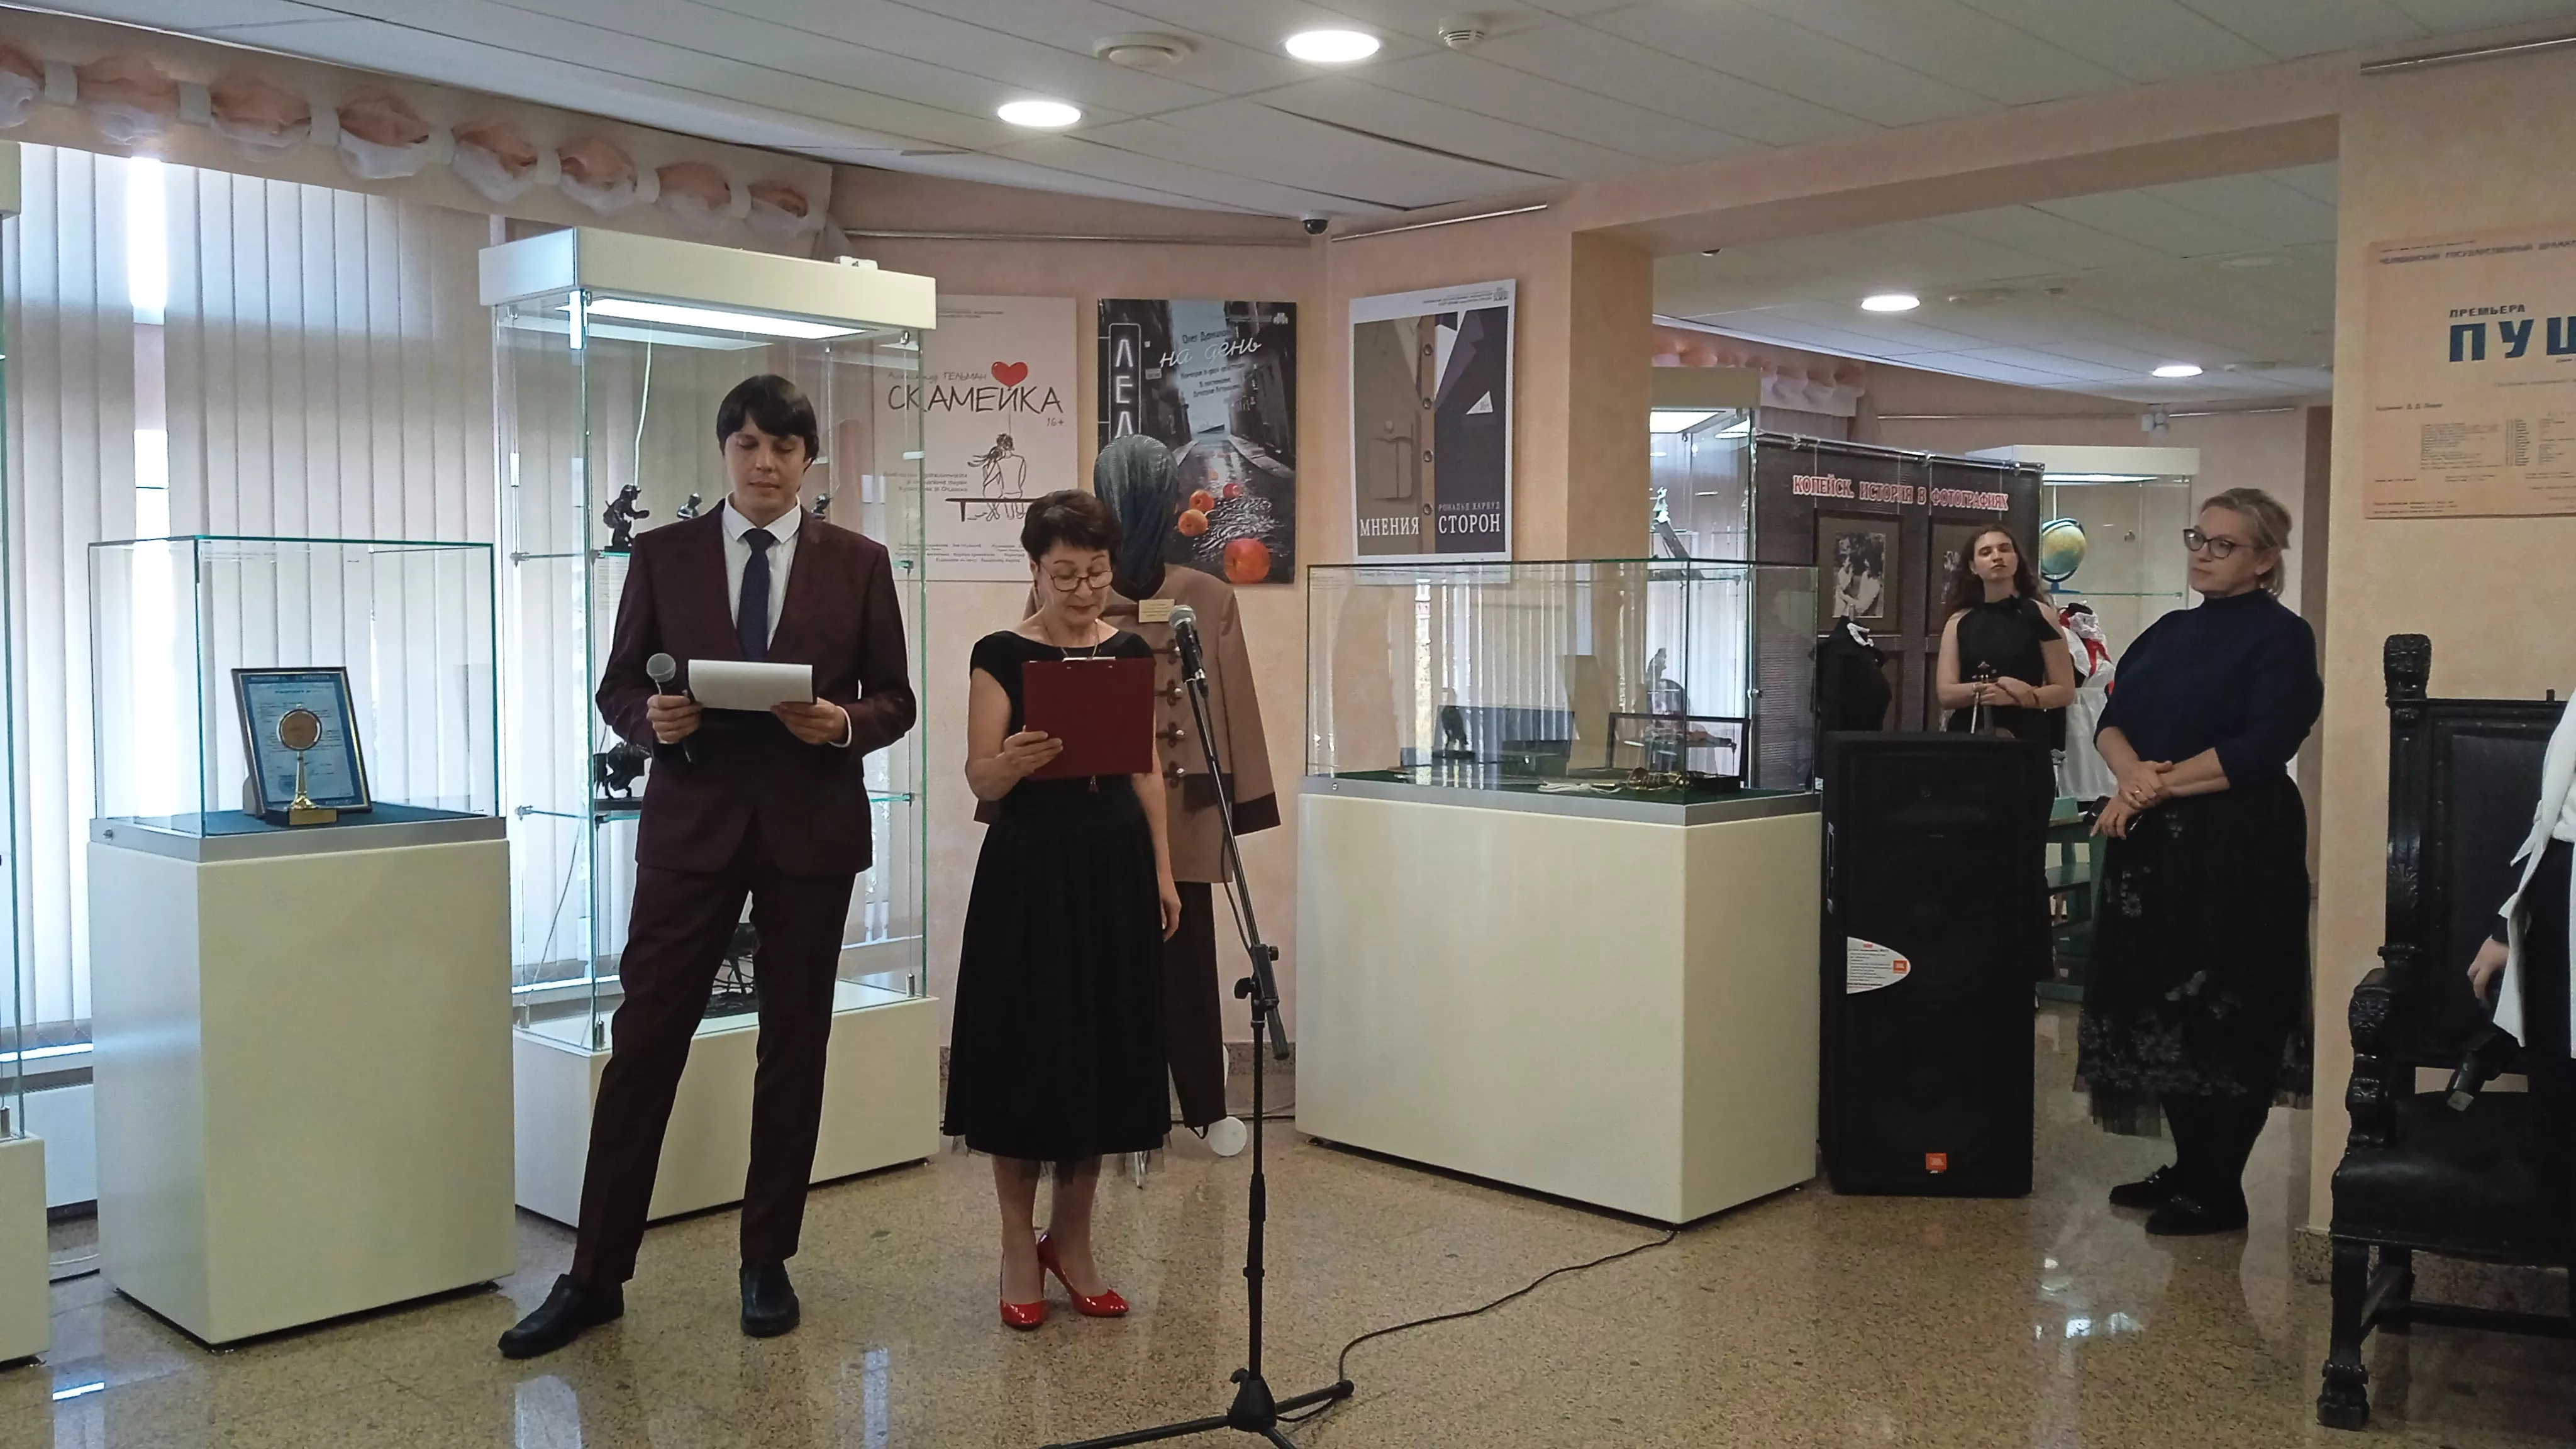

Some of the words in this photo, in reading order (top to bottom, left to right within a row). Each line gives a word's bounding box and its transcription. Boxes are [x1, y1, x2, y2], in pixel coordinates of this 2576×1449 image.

[2450, 304, 2526, 318] ПРЕМЬЕРА
[1159, 348, 1193, 368] на
[1204, 337, 1262, 369] день
[1046, 417, 1065, 427] 16+
[1792, 474, 1855, 498] КОПЕЙСК.
[1859, 481, 1914, 504] ИСТОРИЯ
[1918, 487, 1927, 505] В
[1930, 488, 2009, 511] ФОТОГРАФИЯХ
[1360, 516, 1419, 536] МНЕНИЯ
[1438, 513, 1501, 535] СТОРОН
